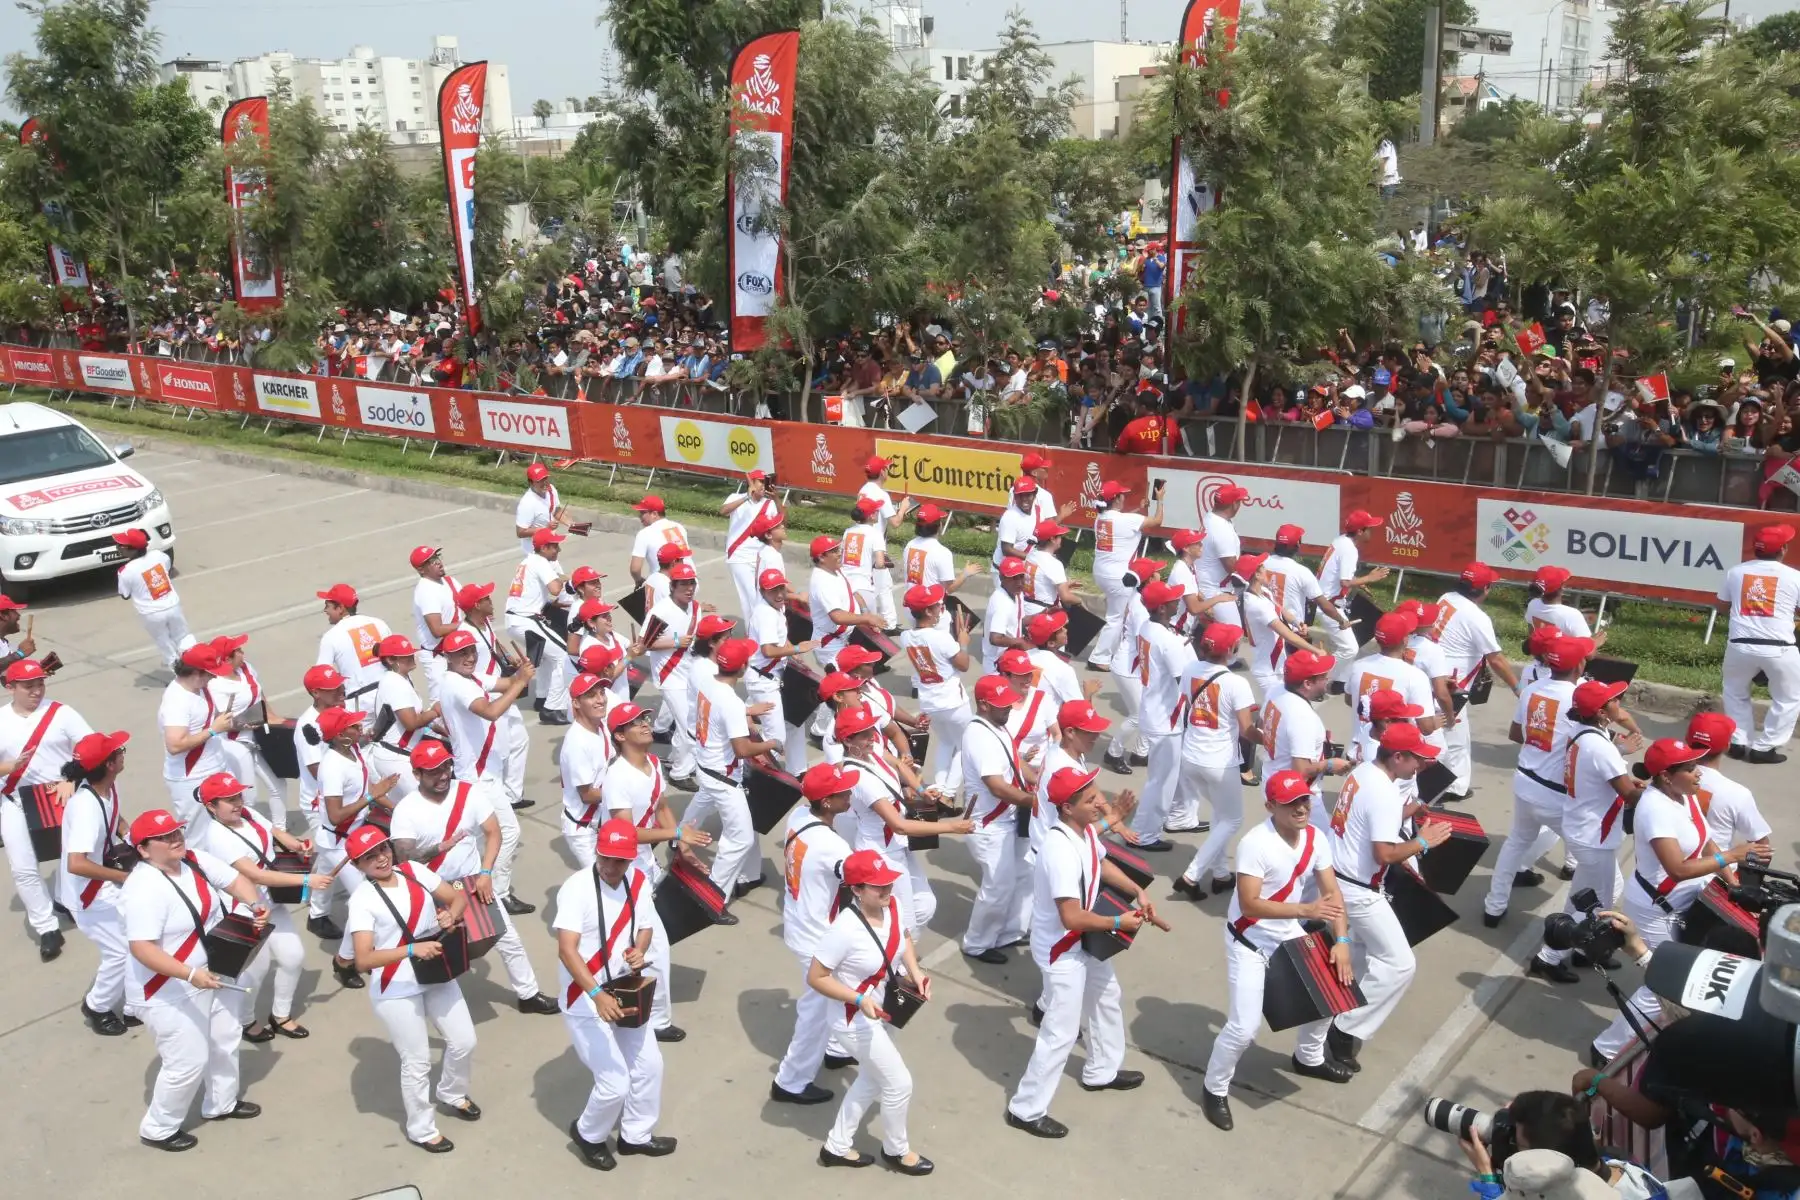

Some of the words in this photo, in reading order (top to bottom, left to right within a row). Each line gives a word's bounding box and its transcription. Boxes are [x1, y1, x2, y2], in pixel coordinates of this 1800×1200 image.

[741, 94, 782, 115] DAKAR
[745, 274, 765, 287] FOX
[86, 365, 127, 378] BFGoodrich
[172, 377, 212, 392] HONDA
[367, 403, 425, 427] sodexo
[487, 411, 561, 438] TOYOTA
[613, 436, 634, 450] DAKAR
[678, 434, 701, 449] RPP
[730, 440, 756, 456] RPP
[811, 460, 837, 477] DAKAR
[886, 454, 909, 480] El
[913, 457, 1015, 493] Comercio
[50, 479, 119, 496] TOYOTA
[1386, 527, 1427, 549] DAKAR
[1391, 547, 1419, 558] 2018
[1567, 528, 1724, 571] BOLIVIA
